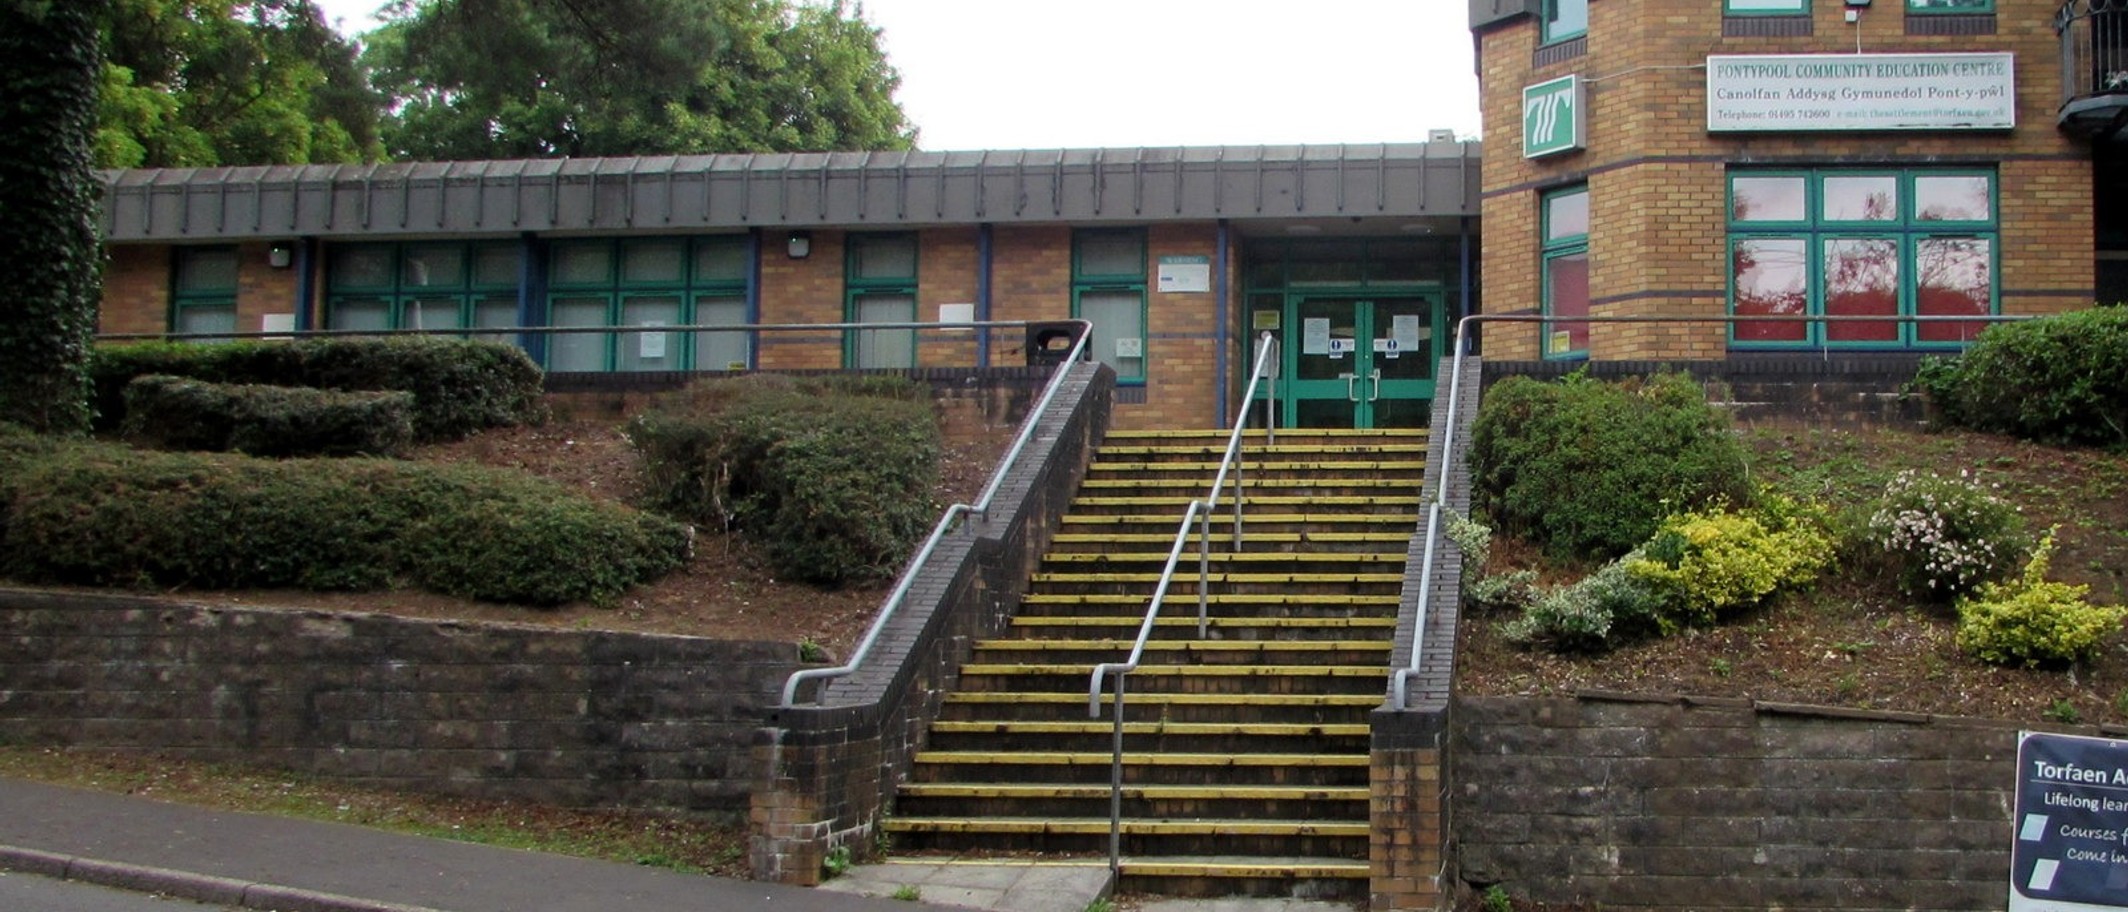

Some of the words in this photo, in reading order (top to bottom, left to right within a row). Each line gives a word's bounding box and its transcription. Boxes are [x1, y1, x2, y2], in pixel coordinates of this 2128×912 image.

[1717, 64, 1791, 79] PONTYPOOL
[1795, 63, 1872, 78] COMMUNITY
[1876, 63, 1949, 78] EDUCATION
[1953, 62, 2004, 77] CENTRE
[1717, 88, 1780, 100] Canolfan
[1786, 88, 1836, 101] Addysg
[1841, 87, 1922, 101] Gymunedol
[1717, 109, 1767, 120] Telephone:
[1768, 109, 1794, 119] 01495
[1798, 109, 1830, 119] 742600
[2034, 760, 2107, 784] Torfaen
[2112, 767, 2128, 785] A
[2044, 792, 2099, 812] Lifelong
[2060, 824, 2117, 841] Courses
[2066, 847, 2107, 863] Come
